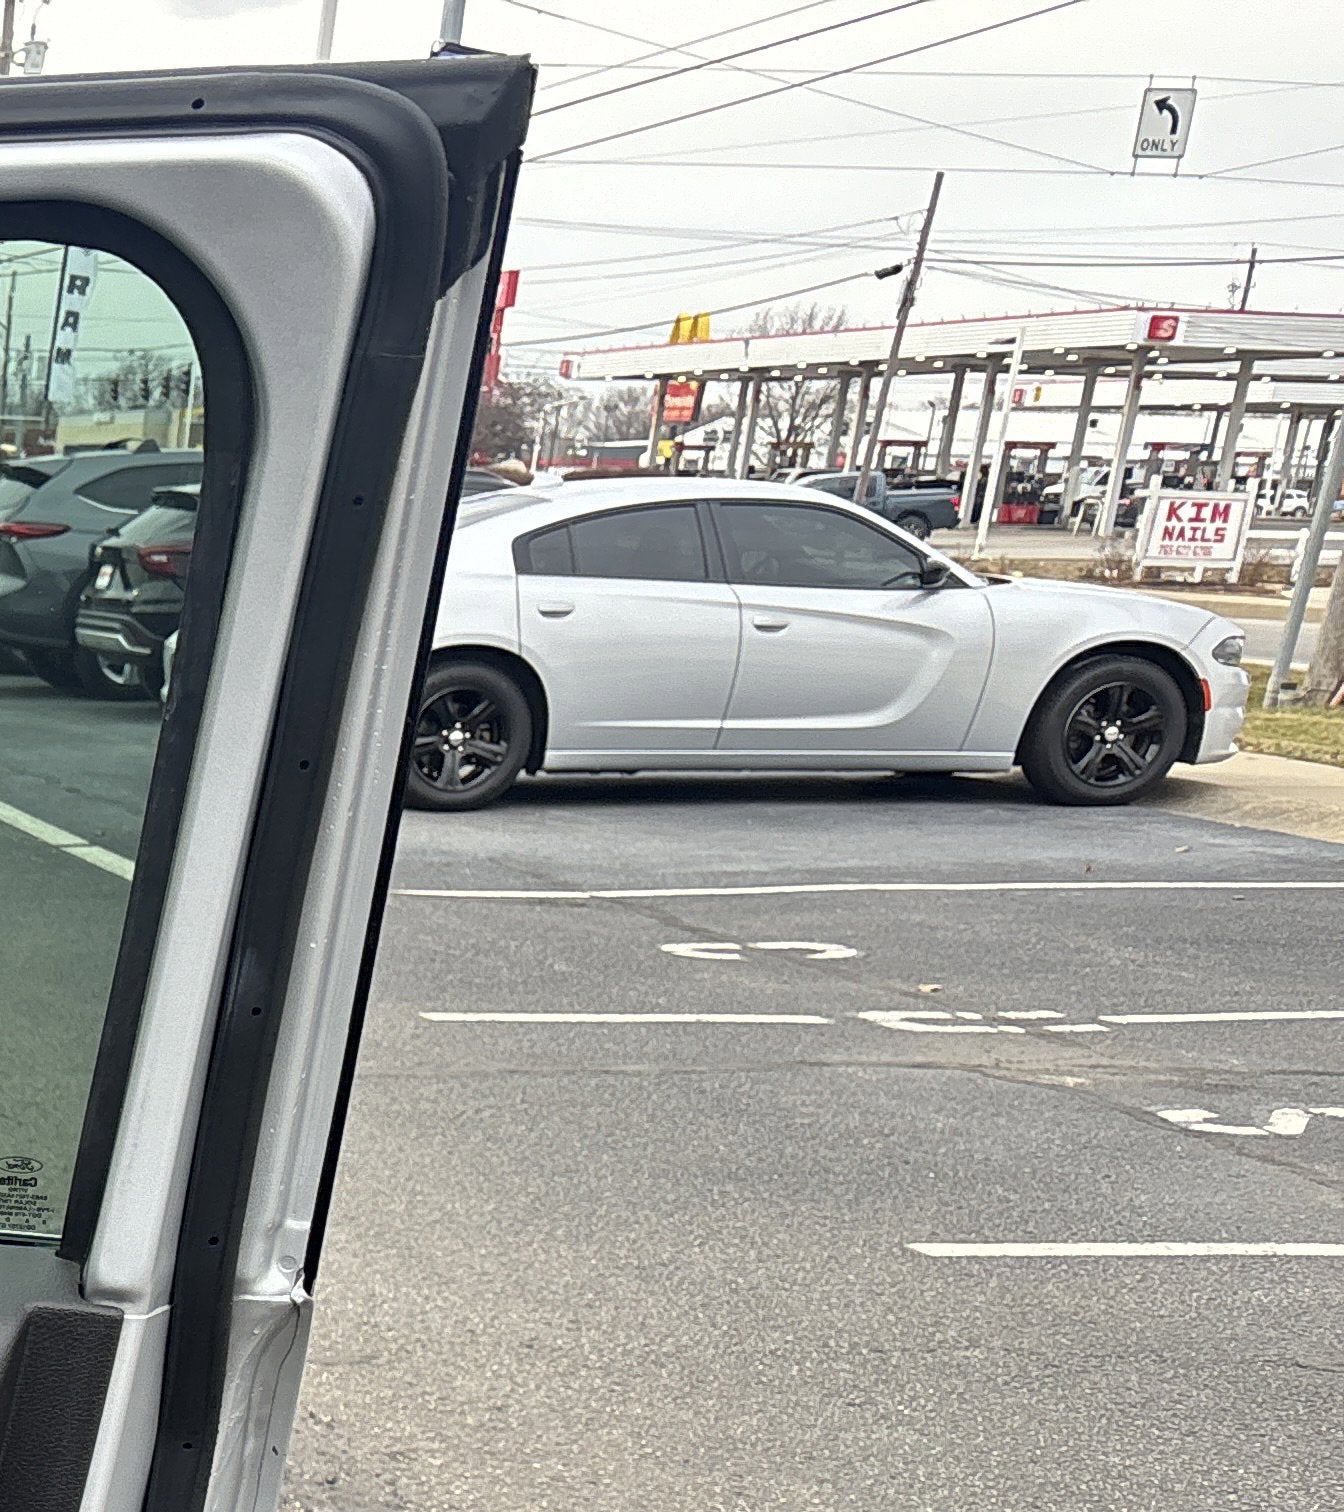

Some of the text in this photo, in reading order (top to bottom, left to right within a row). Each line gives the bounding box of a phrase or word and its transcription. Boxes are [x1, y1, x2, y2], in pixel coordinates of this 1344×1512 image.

[1140, 138, 1179, 152] ONLY
[55, 274, 90, 365] RAM
[1166, 501, 1232, 524] KIM
[1161, 526, 1227, 543] NAILS
